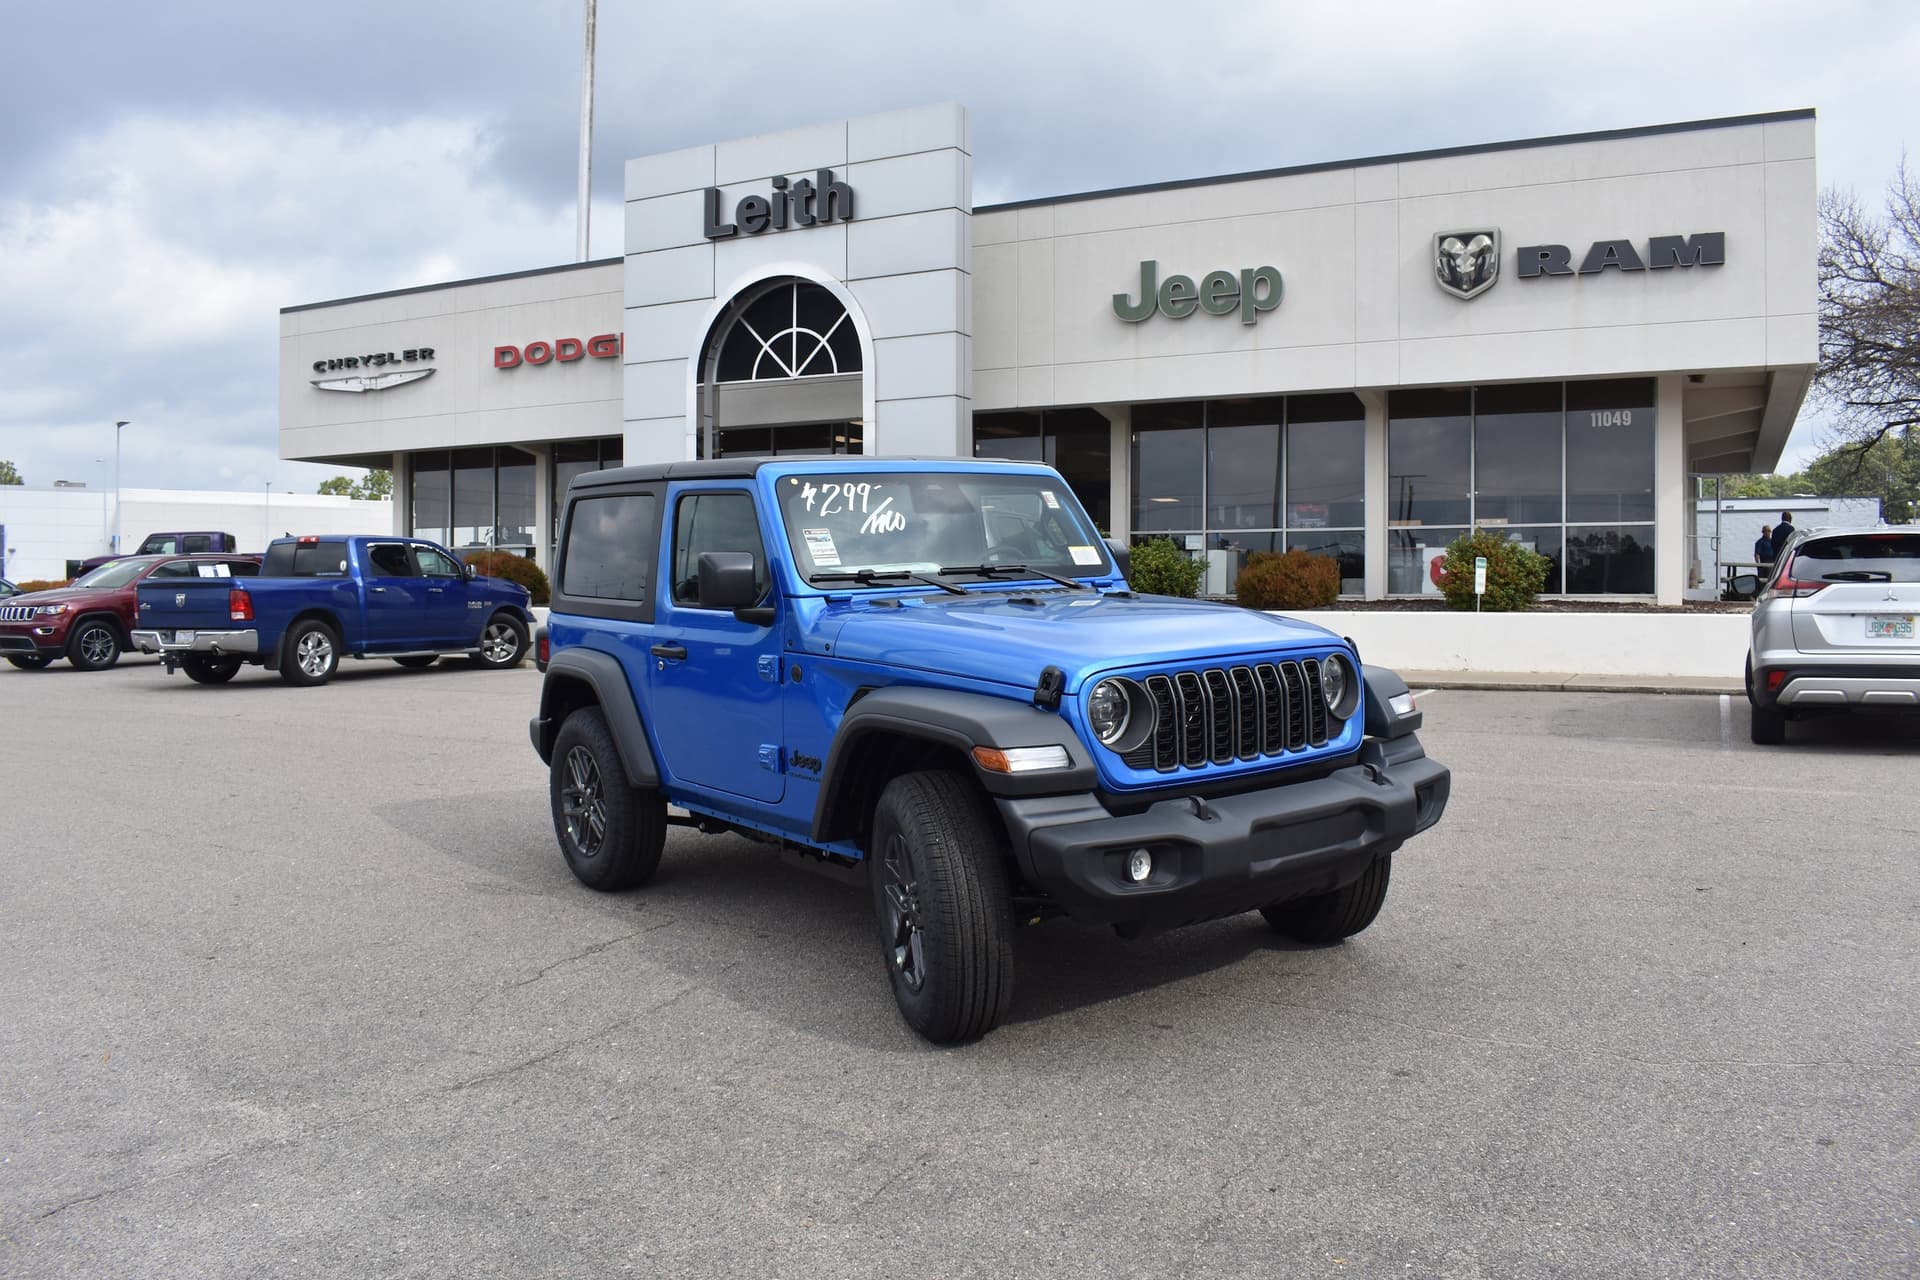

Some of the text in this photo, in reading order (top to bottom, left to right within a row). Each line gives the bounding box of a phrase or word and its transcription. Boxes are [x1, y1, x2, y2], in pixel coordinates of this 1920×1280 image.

[704, 168, 854, 240] Leith
[1517, 232, 1725, 278] RAM
[1112, 260, 1284, 325] Jeep
[313, 347, 435, 373] CHRYSLER
[1590, 410, 1632, 428] 11049
[789, 749, 823, 775] Jeep
